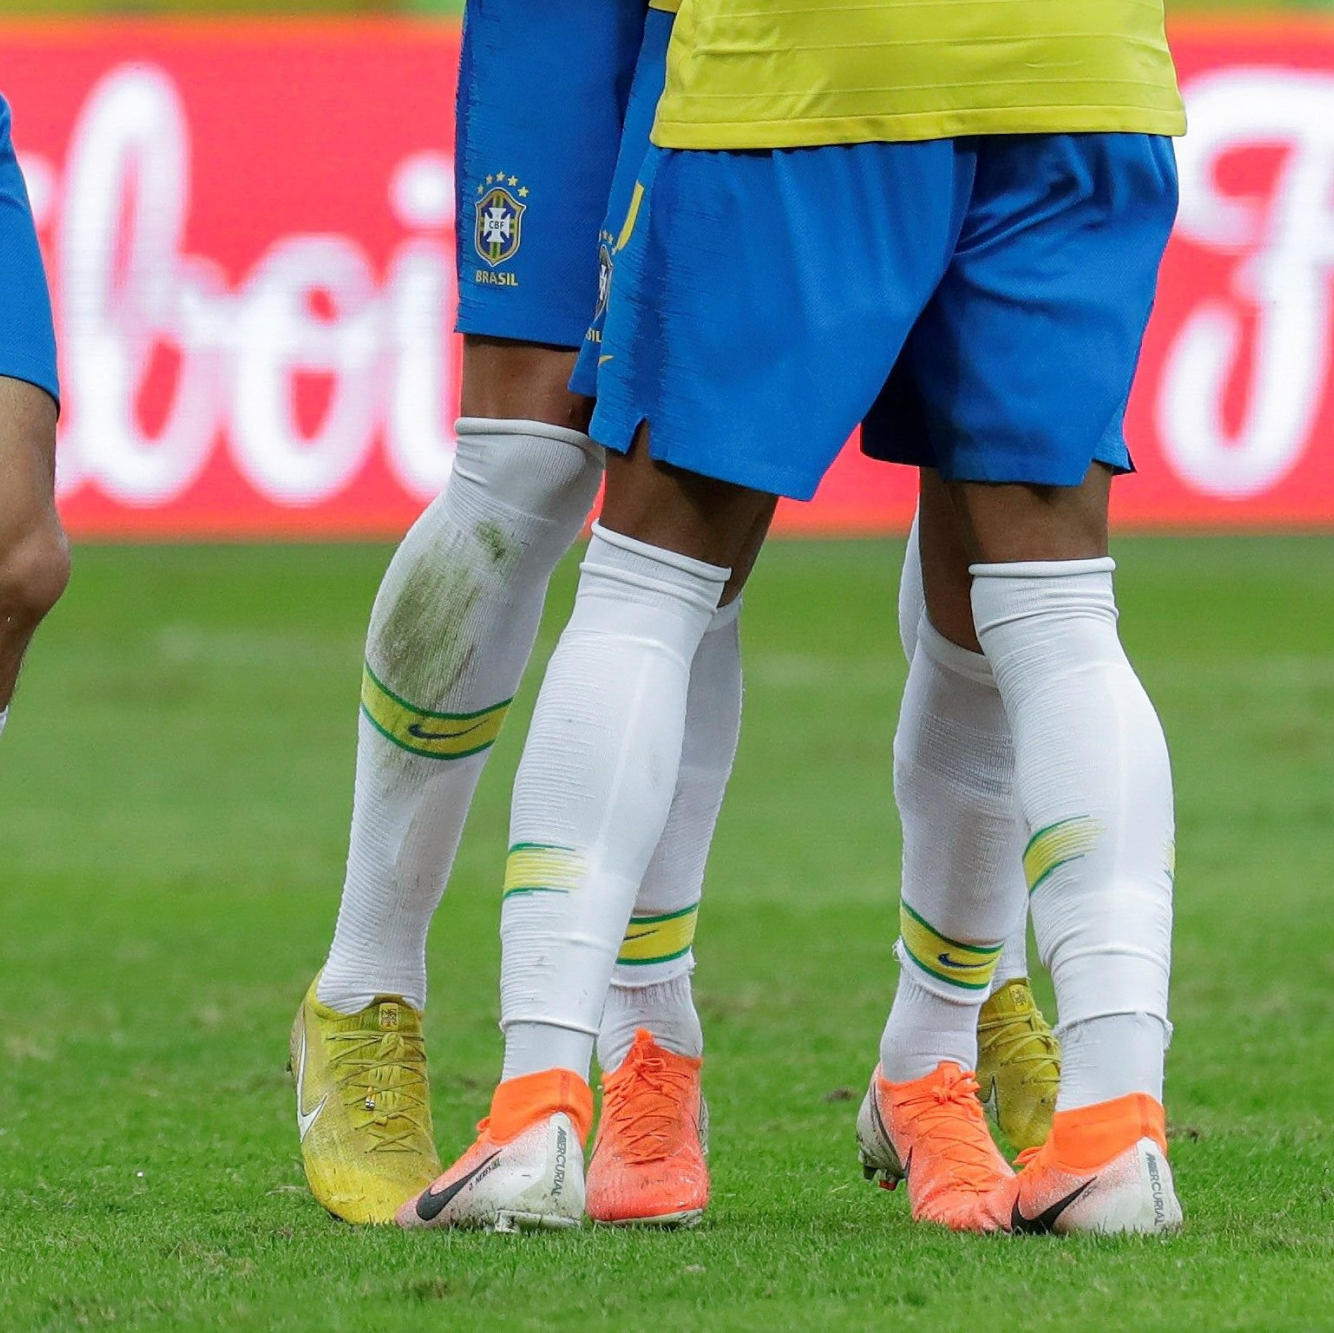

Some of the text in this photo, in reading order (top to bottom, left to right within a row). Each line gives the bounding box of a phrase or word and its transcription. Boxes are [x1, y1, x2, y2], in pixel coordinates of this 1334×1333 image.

[489, 220, 505, 230] CBF
[475, 270, 519, 286] BRASIL
[551, 1126, 567, 1196] MERCURIAL
[1146, 1152, 1165, 1225] MERCURIAL
